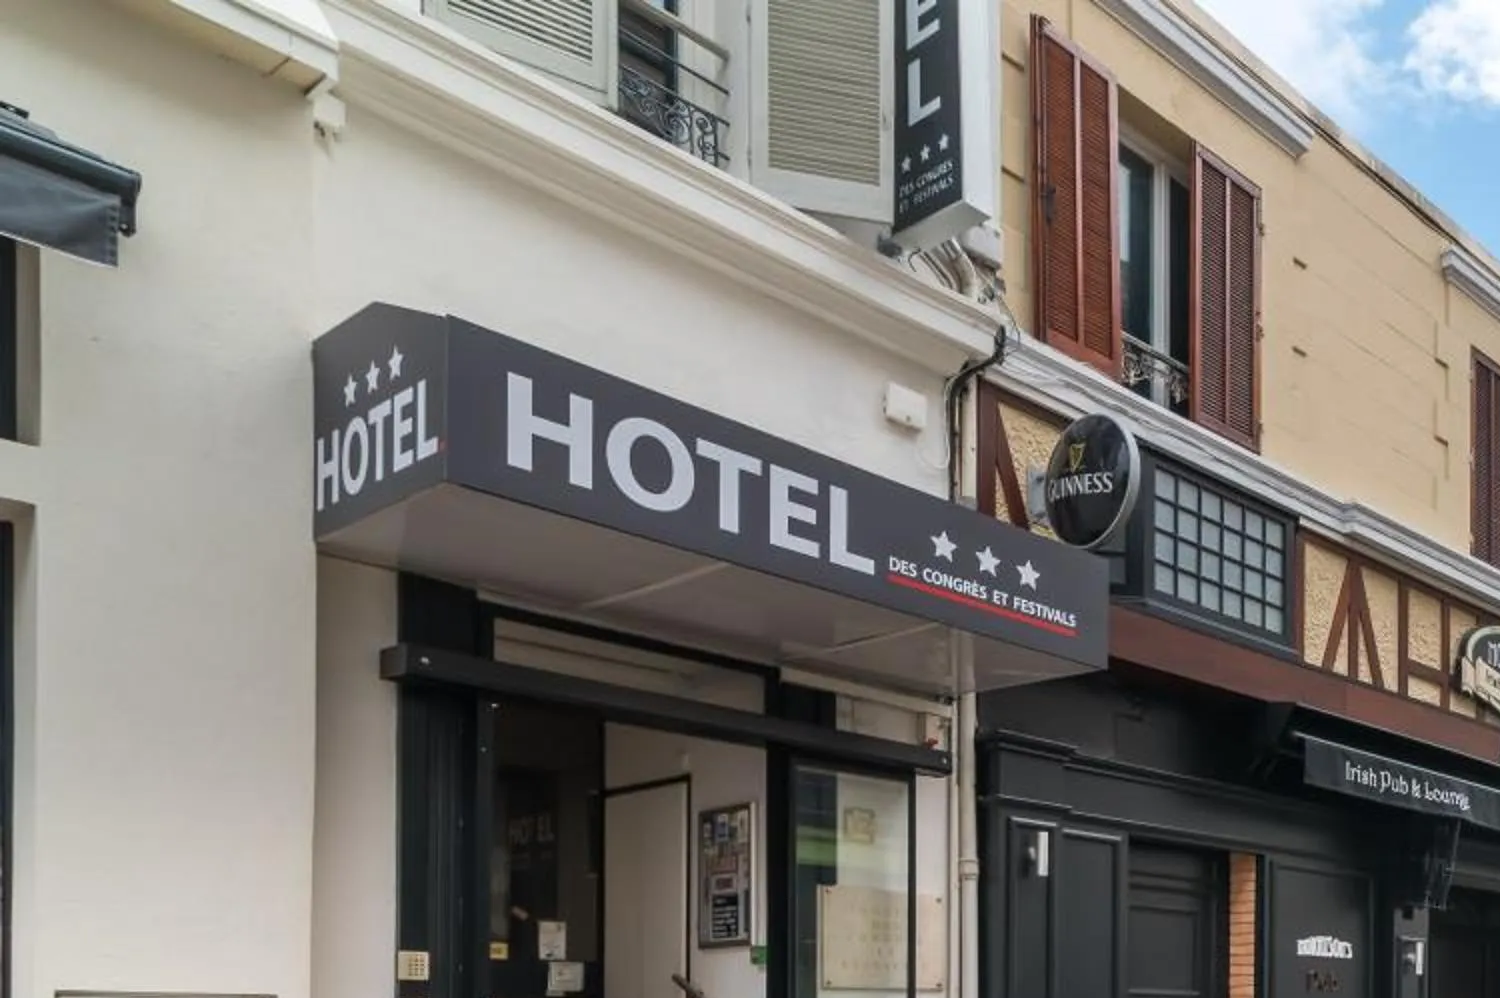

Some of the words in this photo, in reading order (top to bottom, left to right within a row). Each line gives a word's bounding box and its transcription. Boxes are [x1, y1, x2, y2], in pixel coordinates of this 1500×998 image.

[317, 378, 439, 511] HOTEL
[507, 371, 875, 576] HOTEL
[1047, 471, 1113, 503] GUINNESS
[889, 556, 917, 577] DES
[923, 567, 987, 600] CONGRÈS
[993, 590, 1009, 606] ET
[1013, 597, 1077, 628] FESTIVALS
[1345, 760, 1377, 787] Irish
[1380, 770, 1409, 795] Pub
